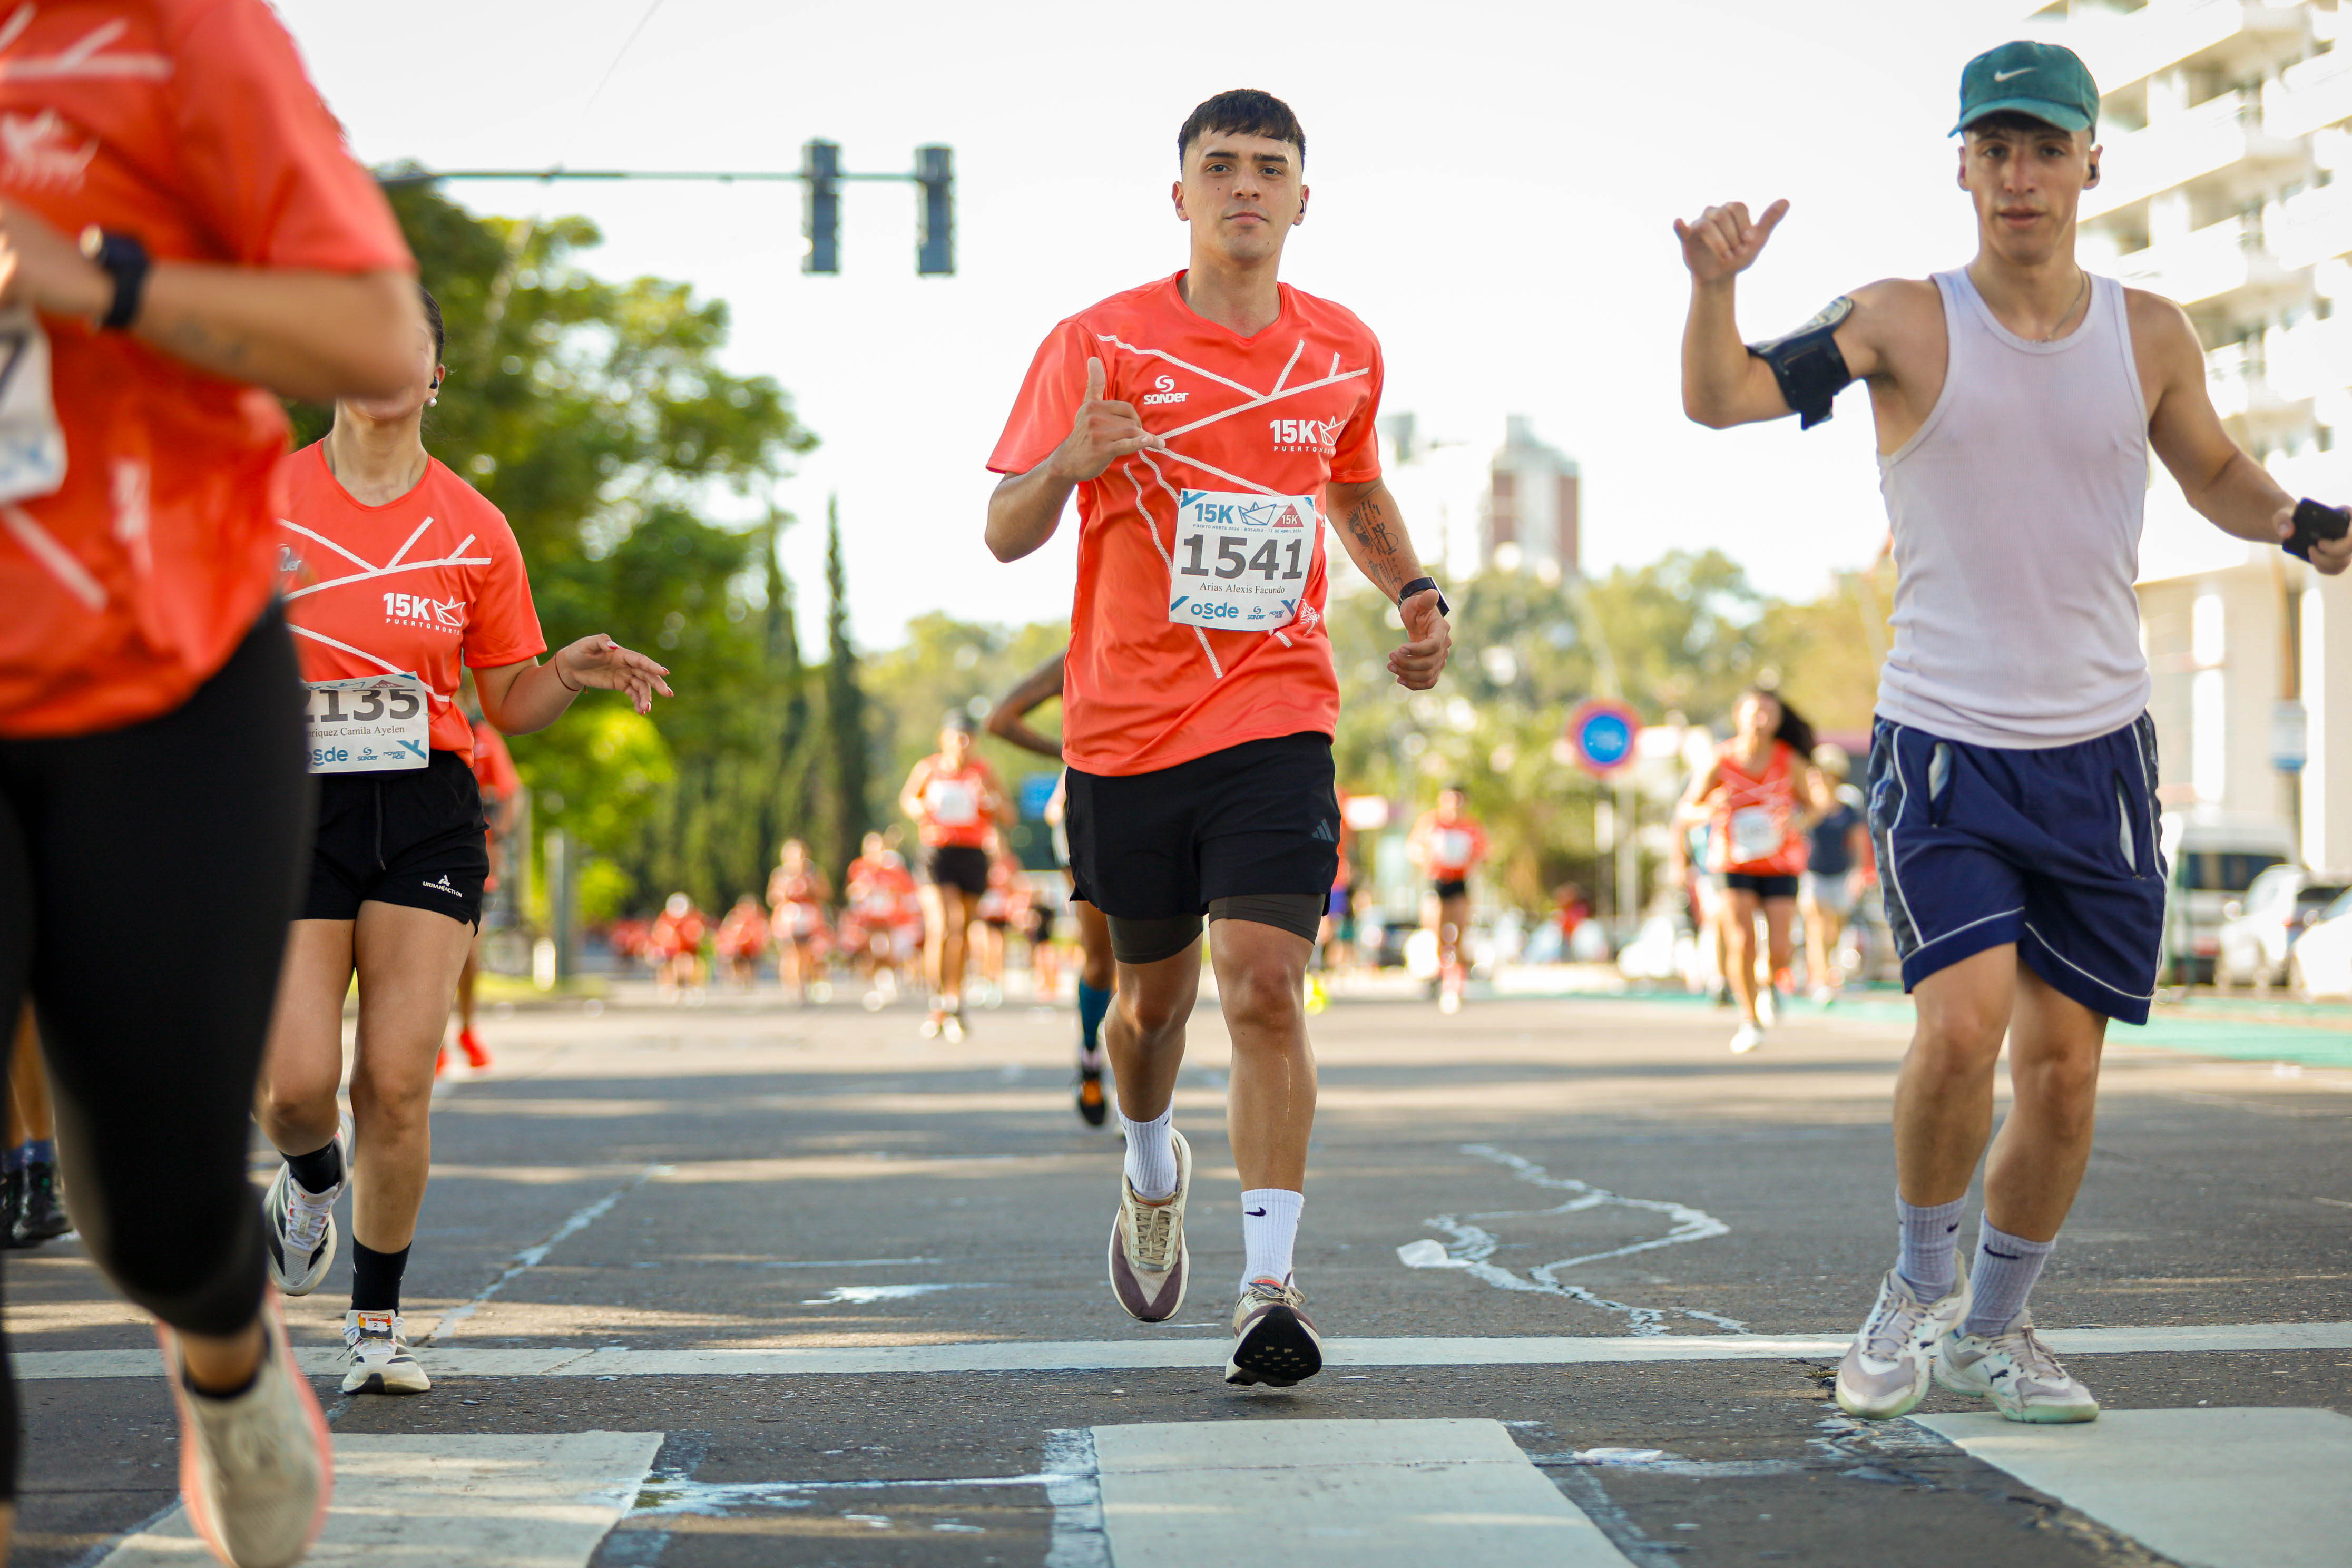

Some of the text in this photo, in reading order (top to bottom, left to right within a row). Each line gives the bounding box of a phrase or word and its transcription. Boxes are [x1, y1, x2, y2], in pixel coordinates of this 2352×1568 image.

[1270, 419, 1317, 444] 15K
[1194, 503, 1234, 524] 15K
[1282, 514, 1298, 524] 15K
[1181, 534, 1302, 580] 1541
[1199, 582, 1285, 594] Arias Alexis Facundo
[383, 592, 431, 621] 15K
[1191, 602, 1239, 619] osde
[386, 618, 460, 635] PUERTO NORTE
[307, 726, 405, 739] nriquez Camila Ayelen
